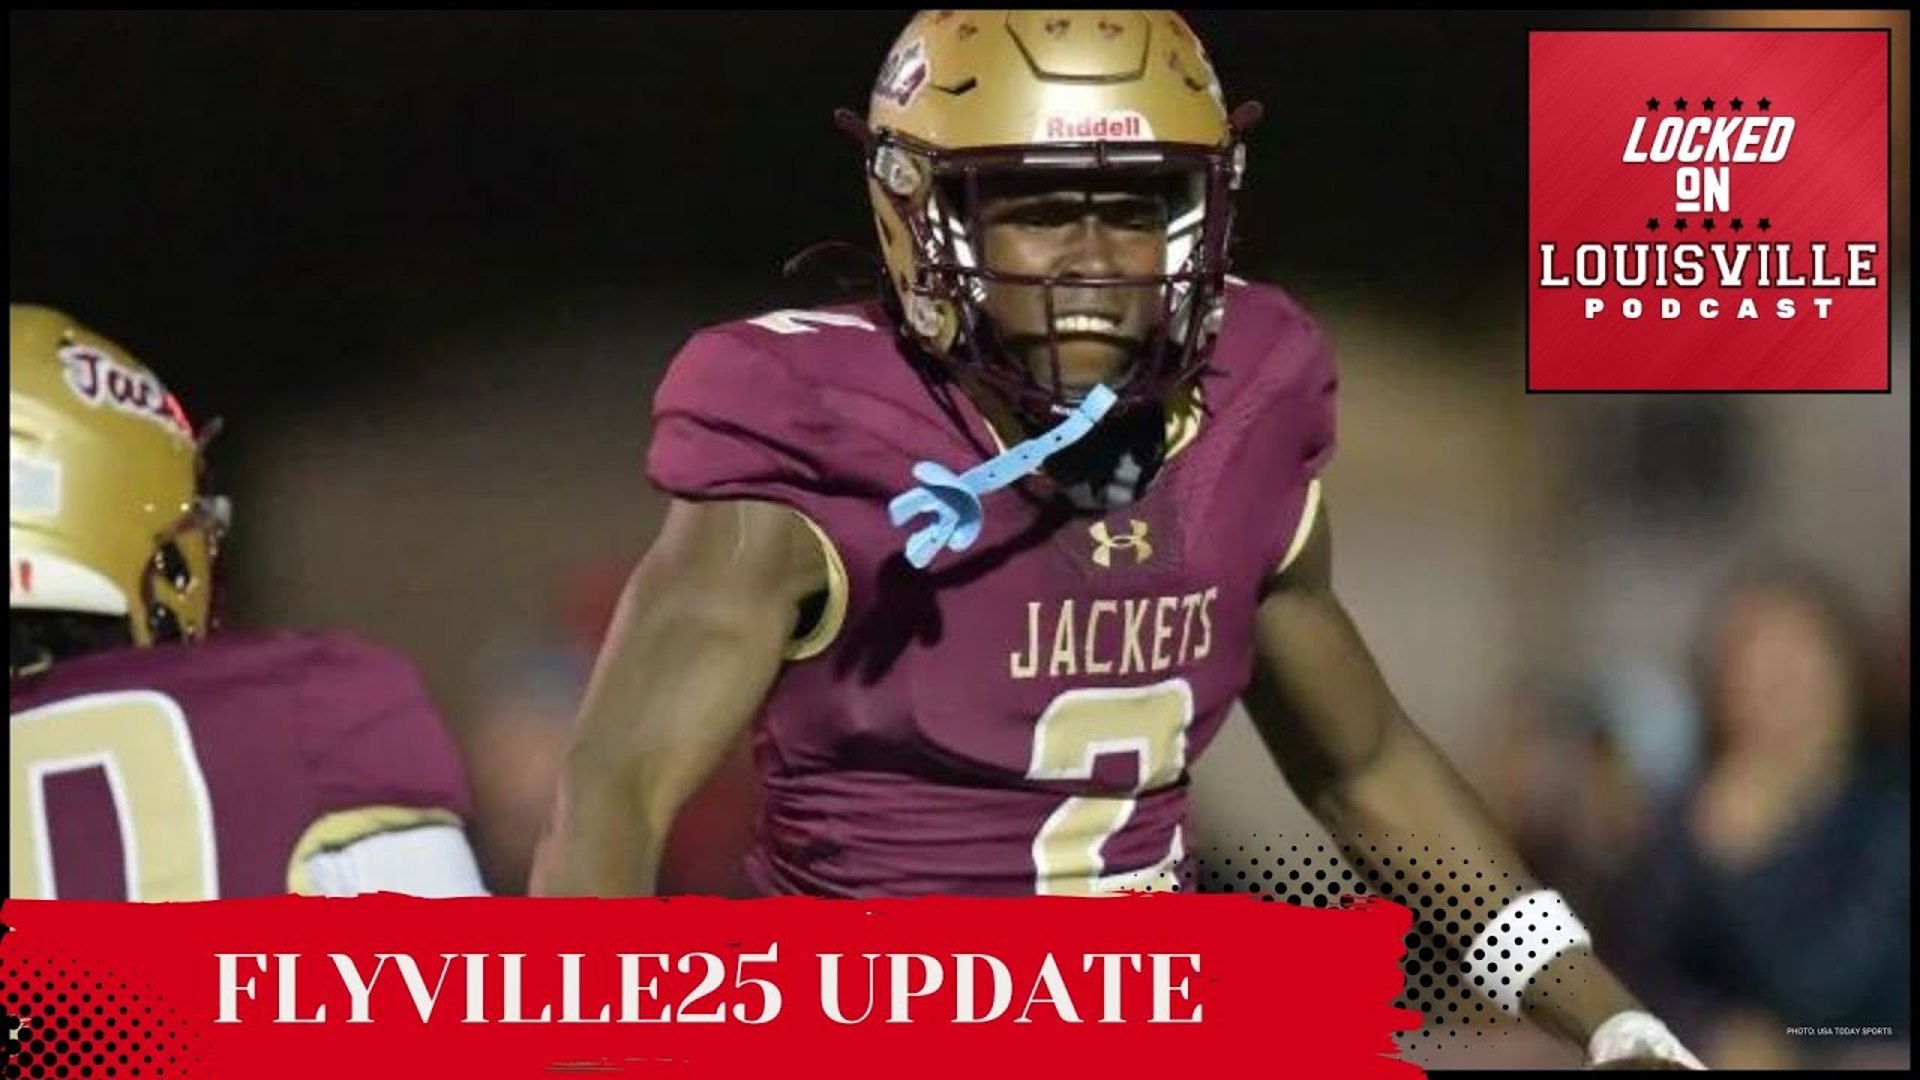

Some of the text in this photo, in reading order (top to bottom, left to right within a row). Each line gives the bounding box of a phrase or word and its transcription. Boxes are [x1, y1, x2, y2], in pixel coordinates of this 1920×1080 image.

[1046, 116, 1140, 137] Riddell
[1010, 587, 1217, 679] JACKETS
[1025, 679, 1194, 896] 2
